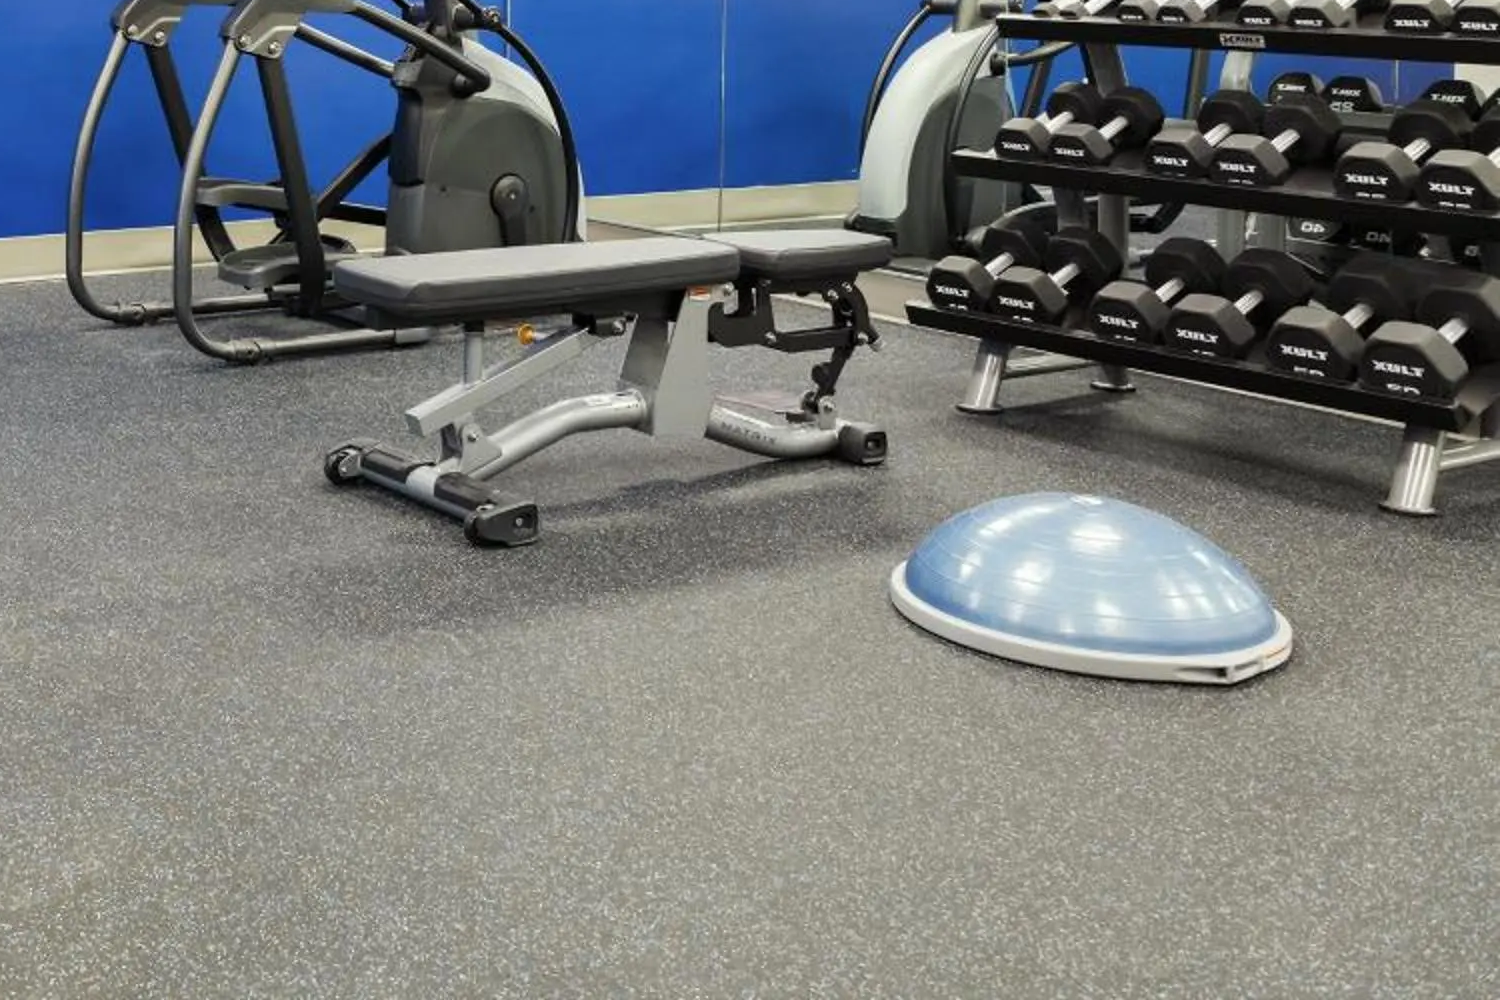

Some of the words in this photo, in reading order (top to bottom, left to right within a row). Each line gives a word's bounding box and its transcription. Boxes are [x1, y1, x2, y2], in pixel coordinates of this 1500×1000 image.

[1344, 173, 1388, 186] XULT
[1428, 181, 1475, 196] XULT
[1280, 343, 1329, 361] XULT
[1371, 359, 1425, 378] XULT
